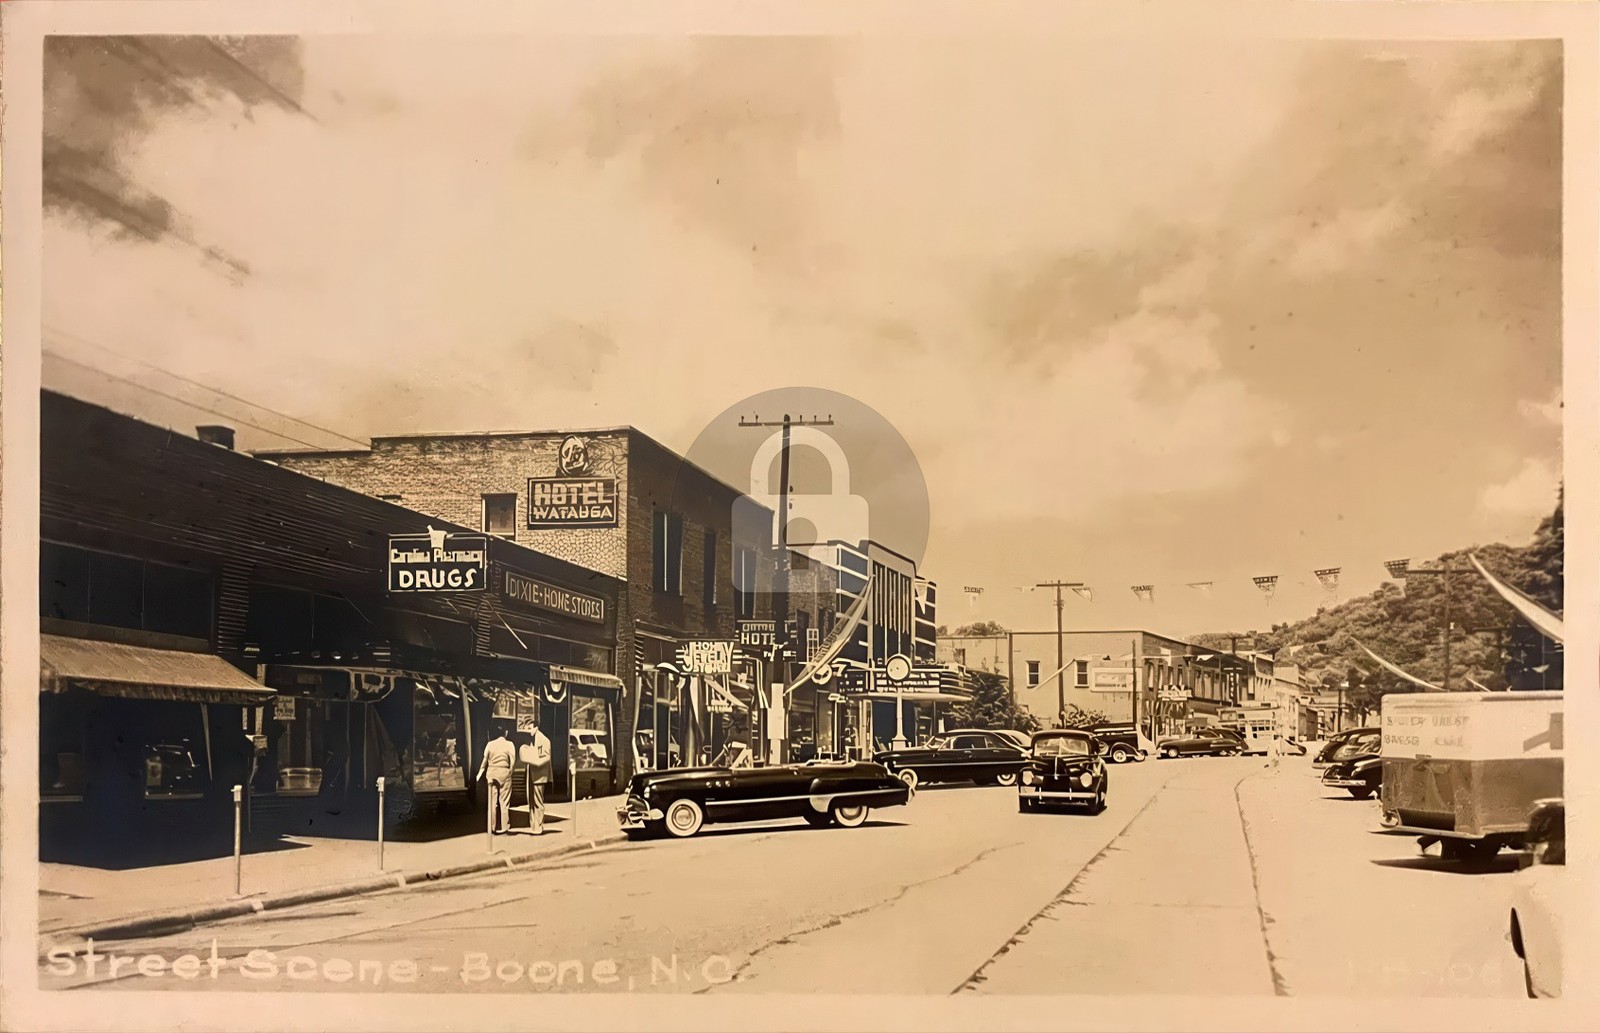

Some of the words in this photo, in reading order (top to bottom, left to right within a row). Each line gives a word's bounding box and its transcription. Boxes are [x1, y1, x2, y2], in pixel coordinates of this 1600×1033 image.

[534, 481, 613, 506] HOTEL
[532, 506, 613, 519] WATAUGA
[399, 568, 478, 589] DRUGS
